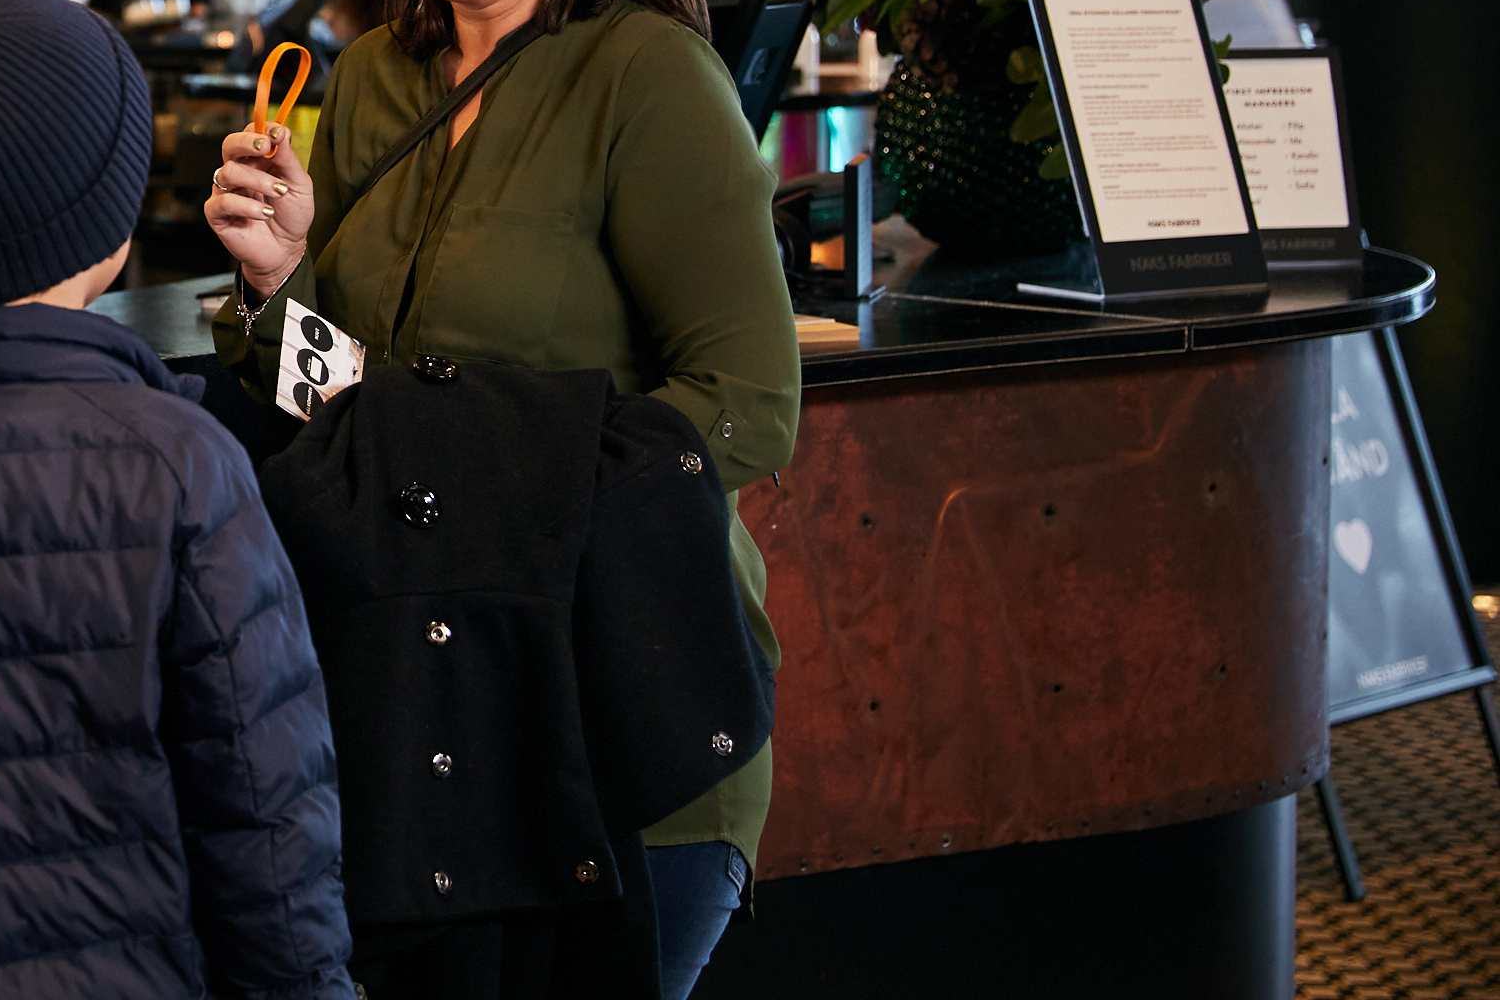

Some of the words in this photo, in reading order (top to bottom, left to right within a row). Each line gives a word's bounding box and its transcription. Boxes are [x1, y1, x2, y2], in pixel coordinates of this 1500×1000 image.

[1255, 86, 1313, 94] IMPRESSION
[1244, 99, 1296, 107] MANAGERS
[1169, 251, 1233, 270] FABRIKER
